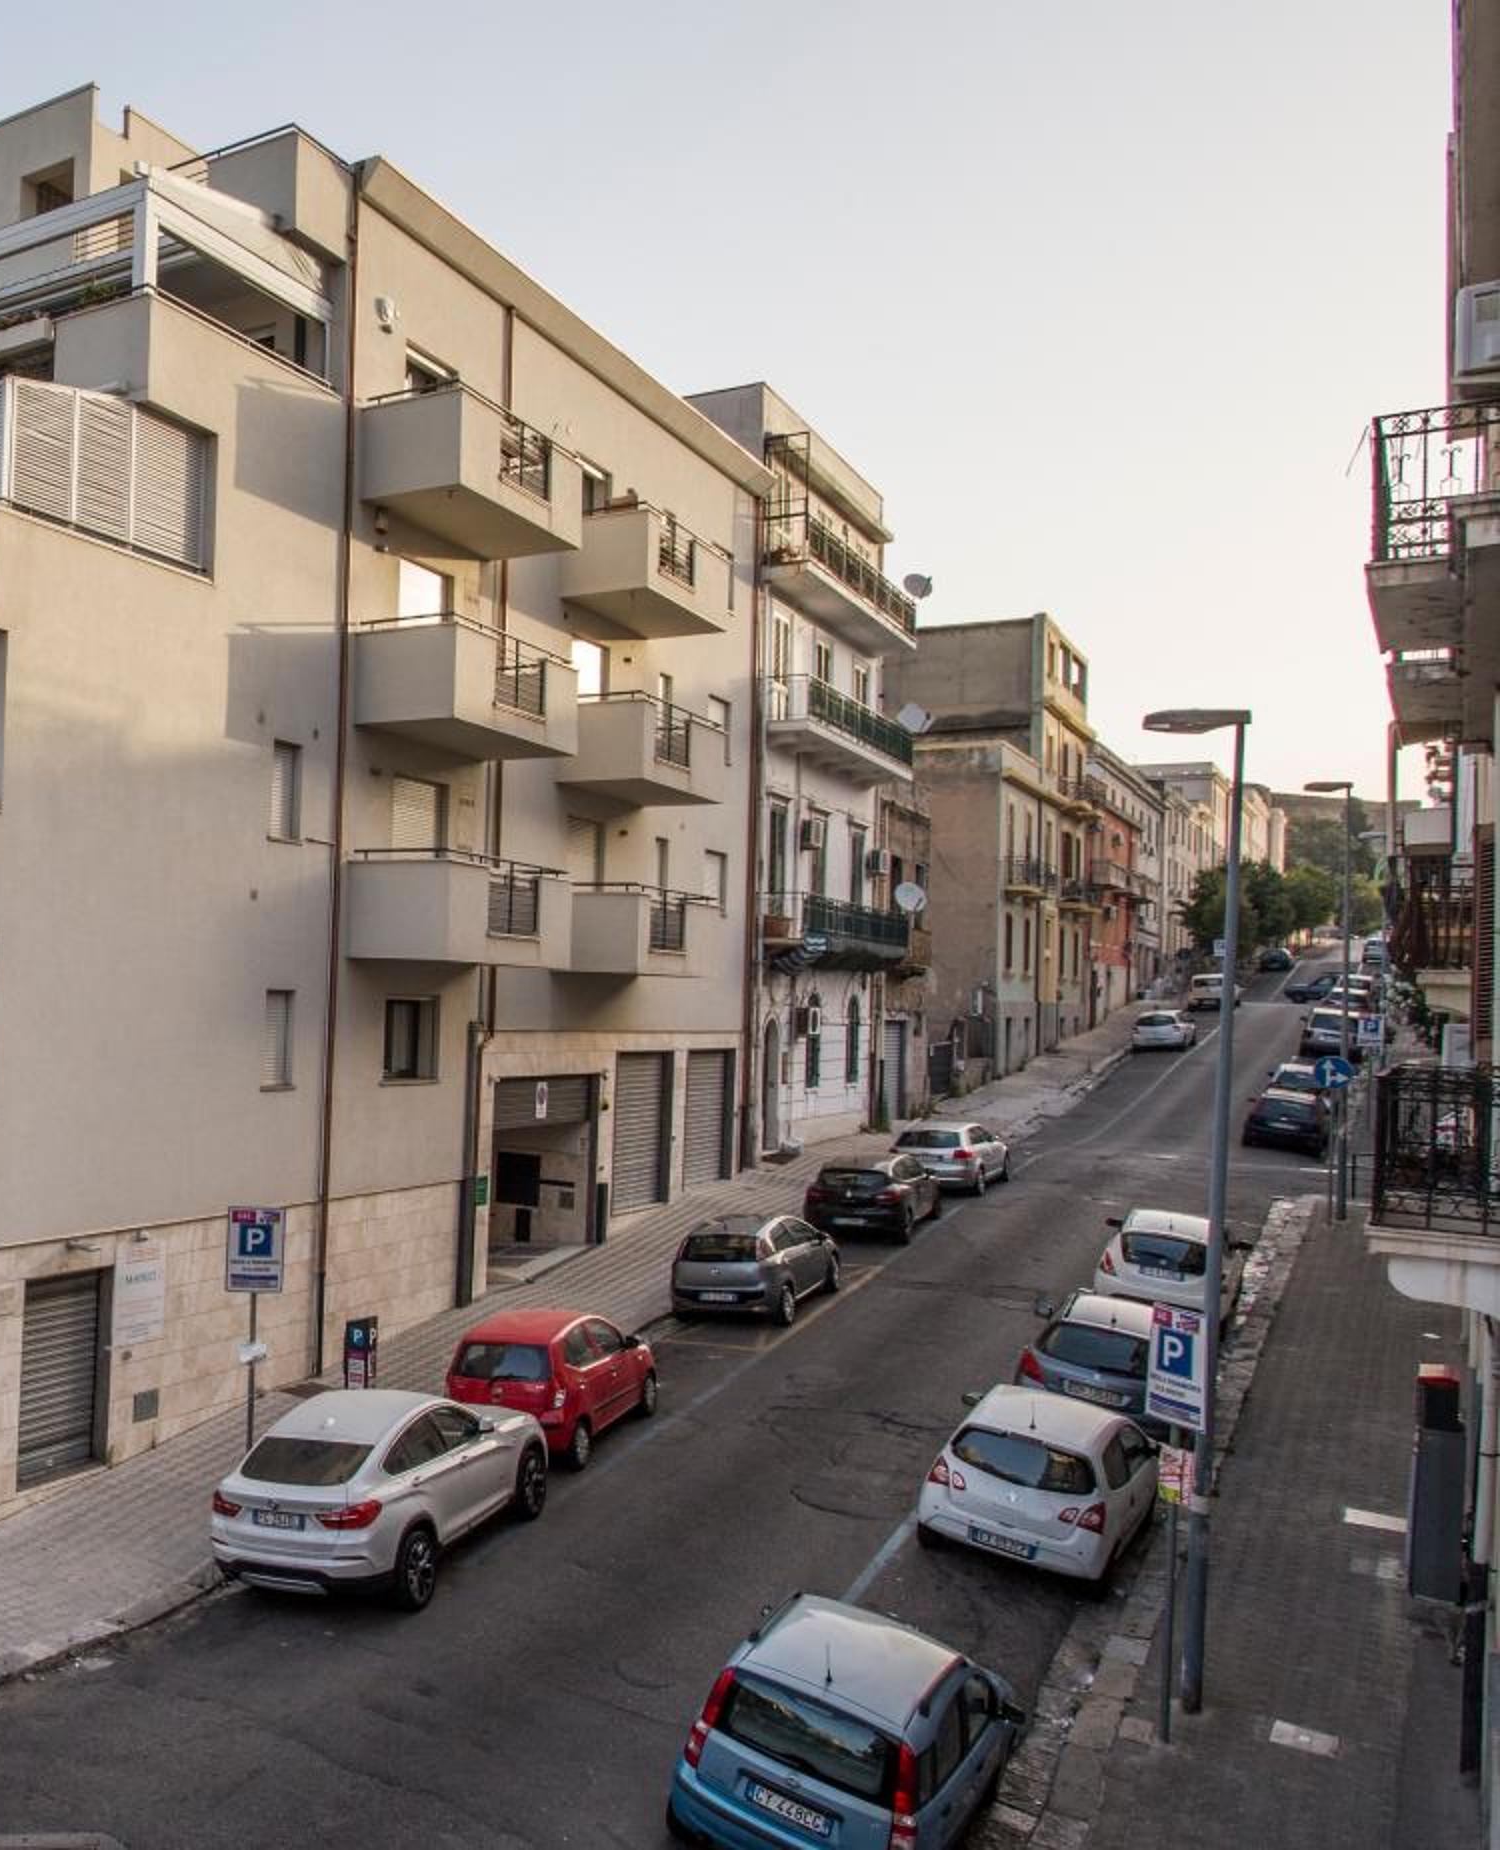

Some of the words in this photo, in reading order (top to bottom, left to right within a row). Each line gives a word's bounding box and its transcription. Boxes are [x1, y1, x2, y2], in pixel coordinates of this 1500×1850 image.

[246, 1227, 266, 1253] P
[353, 1328, 363, 1344] P
[369, 1327, 377, 1345] P
[1162, 1334, 1185, 1367] P
